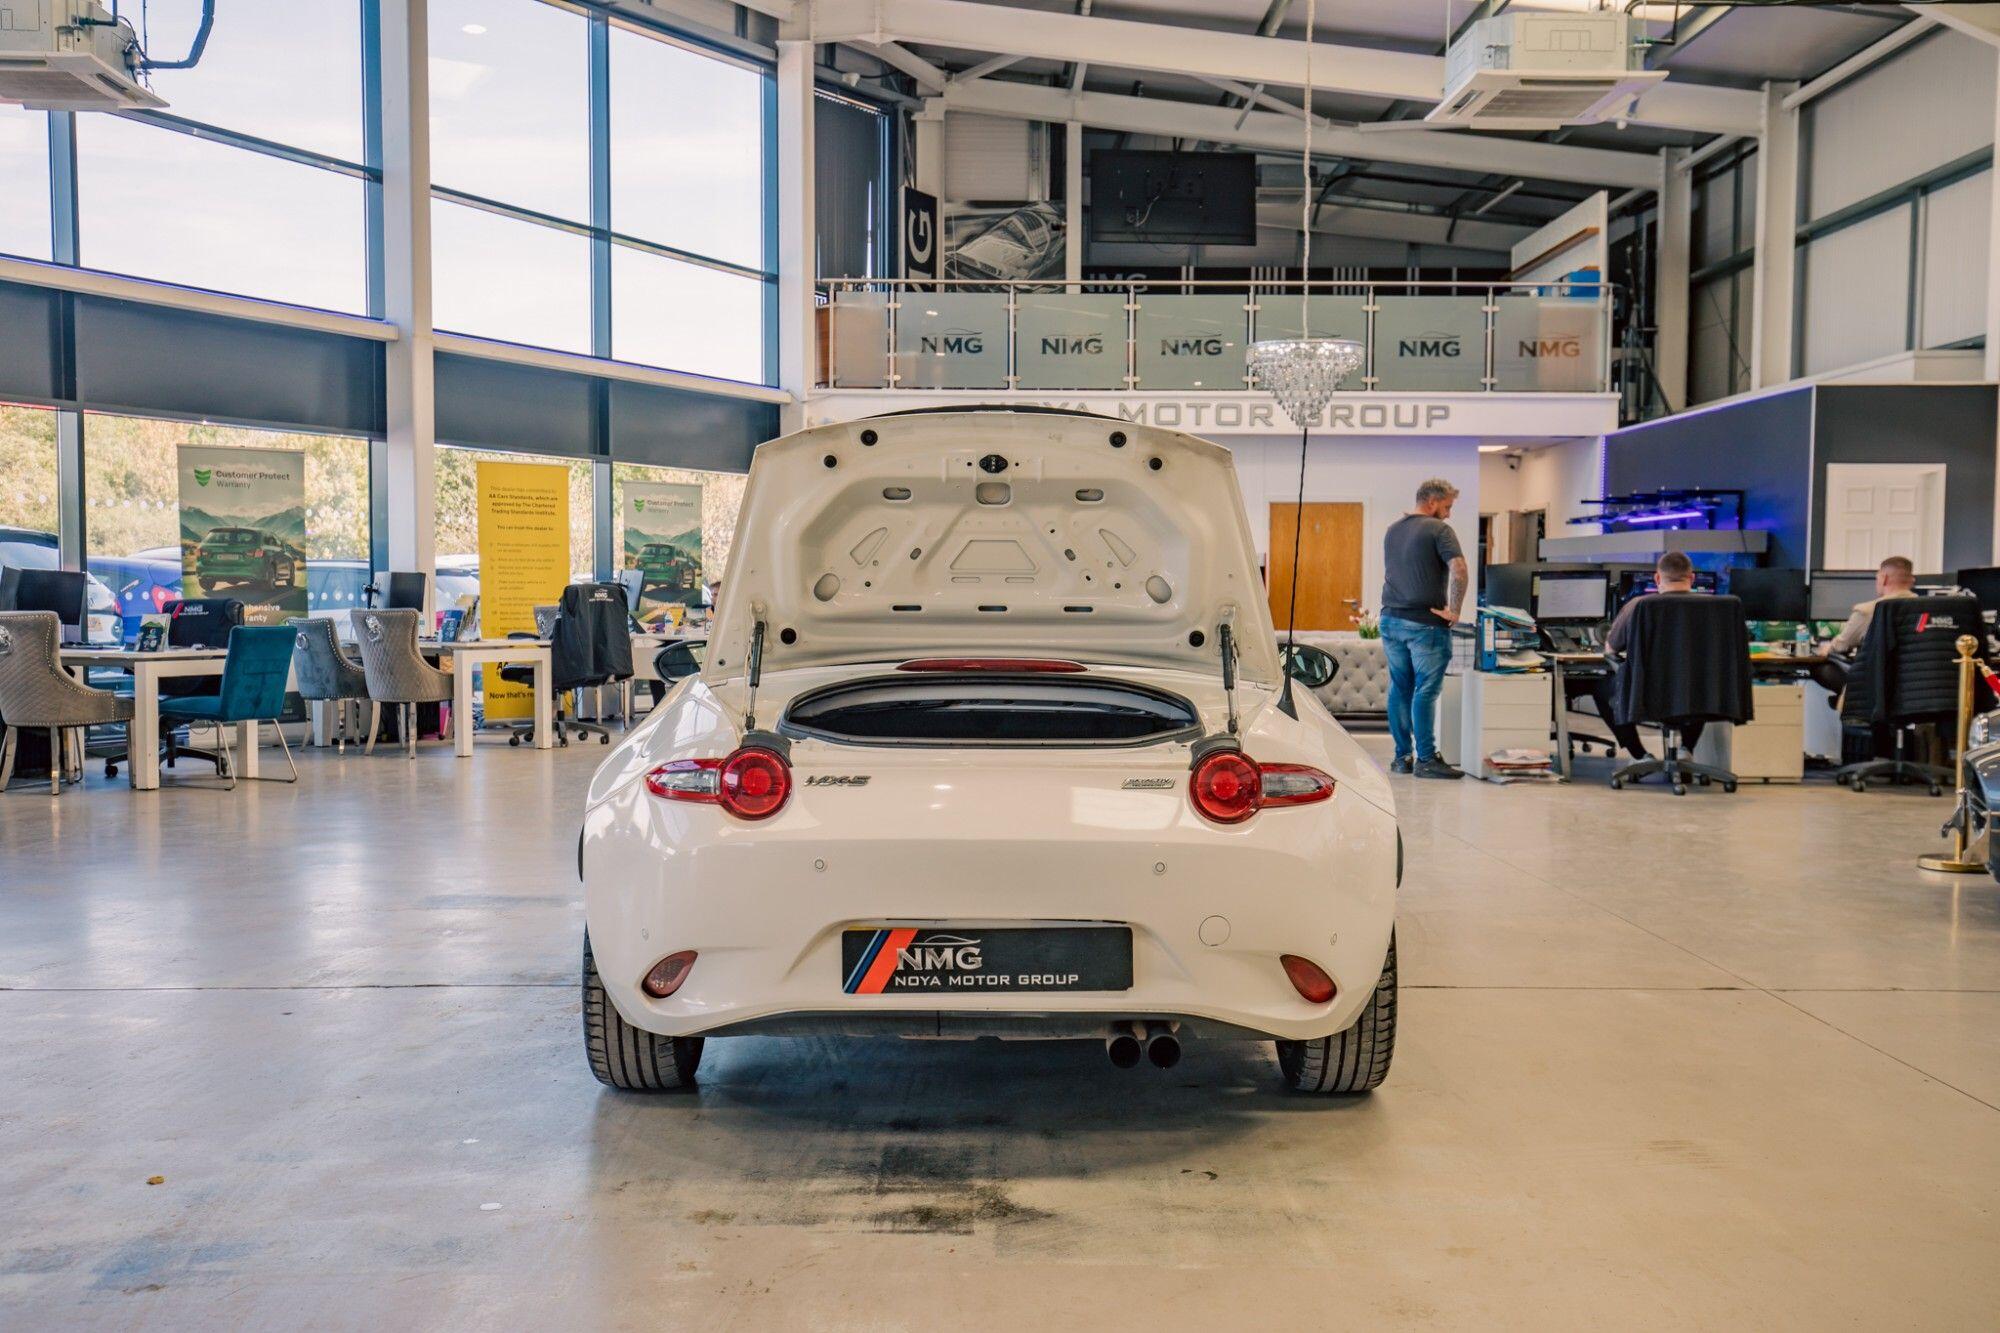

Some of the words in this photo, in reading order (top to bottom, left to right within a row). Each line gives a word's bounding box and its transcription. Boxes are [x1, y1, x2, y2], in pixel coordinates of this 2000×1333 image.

[921, 337, 984, 354] NMG
[1041, 338, 1103, 355] NMG
[1161, 338, 1223, 356] NMG
[1399, 340, 1461, 357] NMG
[1518, 340, 1581, 358] NMG
[1118, 402, 1274, 426] MOTOR
[216, 471, 257, 479] Customer
[259, 472, 290, 480] Protect
[216, 481, 251, 489] Warranty
[896, 947, 982, 970] NMG
[895, 975, 941, 986] NOYA
[949, 974, 1010, 986] MOTOR
[1018, 973, 1079, 985] GROUP
